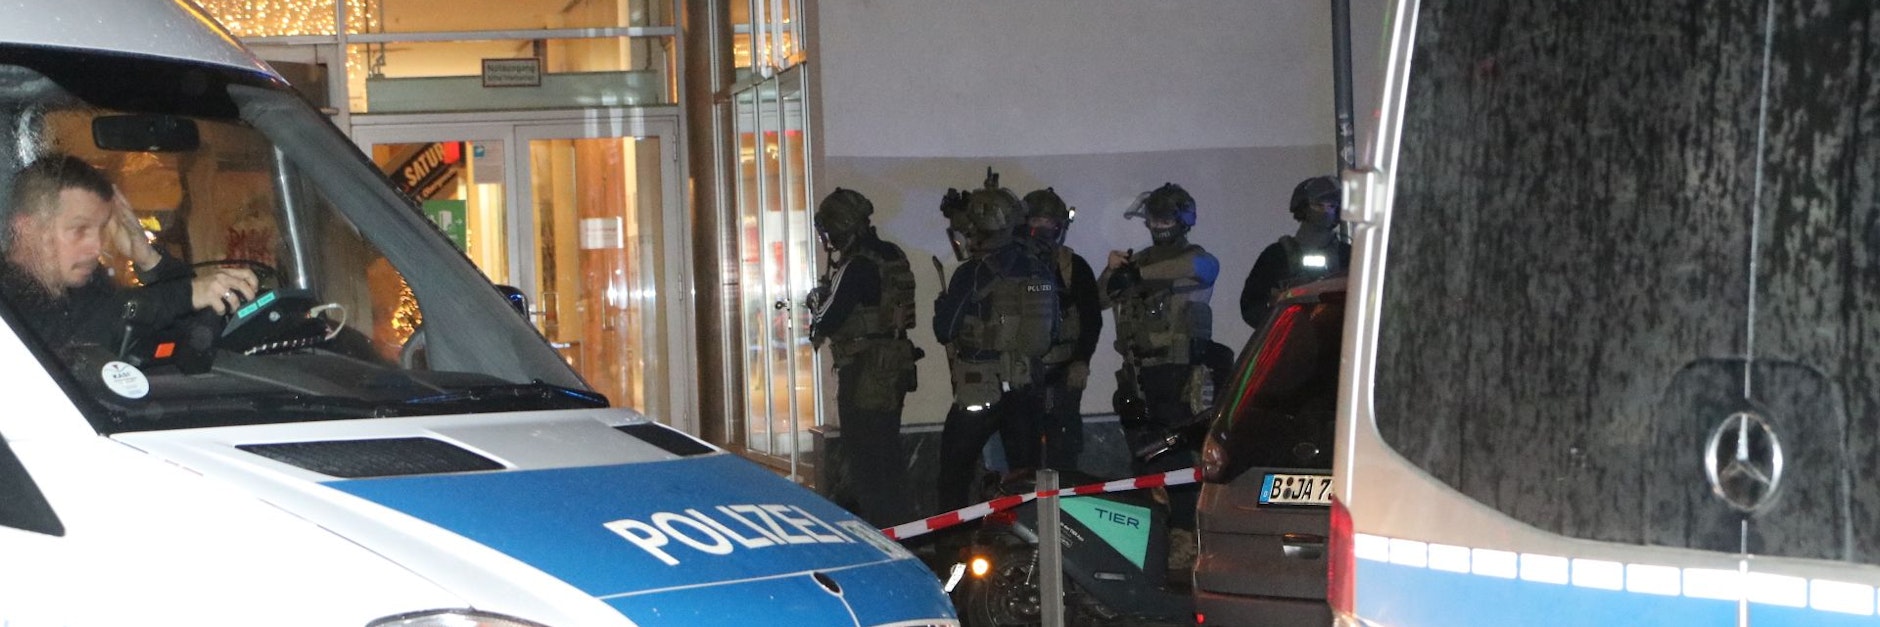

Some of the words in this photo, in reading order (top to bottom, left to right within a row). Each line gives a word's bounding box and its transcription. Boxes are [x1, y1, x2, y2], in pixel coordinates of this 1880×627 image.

[404, 142, 444, 187] SATUR
[1270, 477, 1283, 499] B
[1291, 477, 1314, 500] JA
[1318, 478, 1333, 500] 7
[602, 503, 859, 567] POLIZEI
[1095, 507, 1140, 530] TIER
